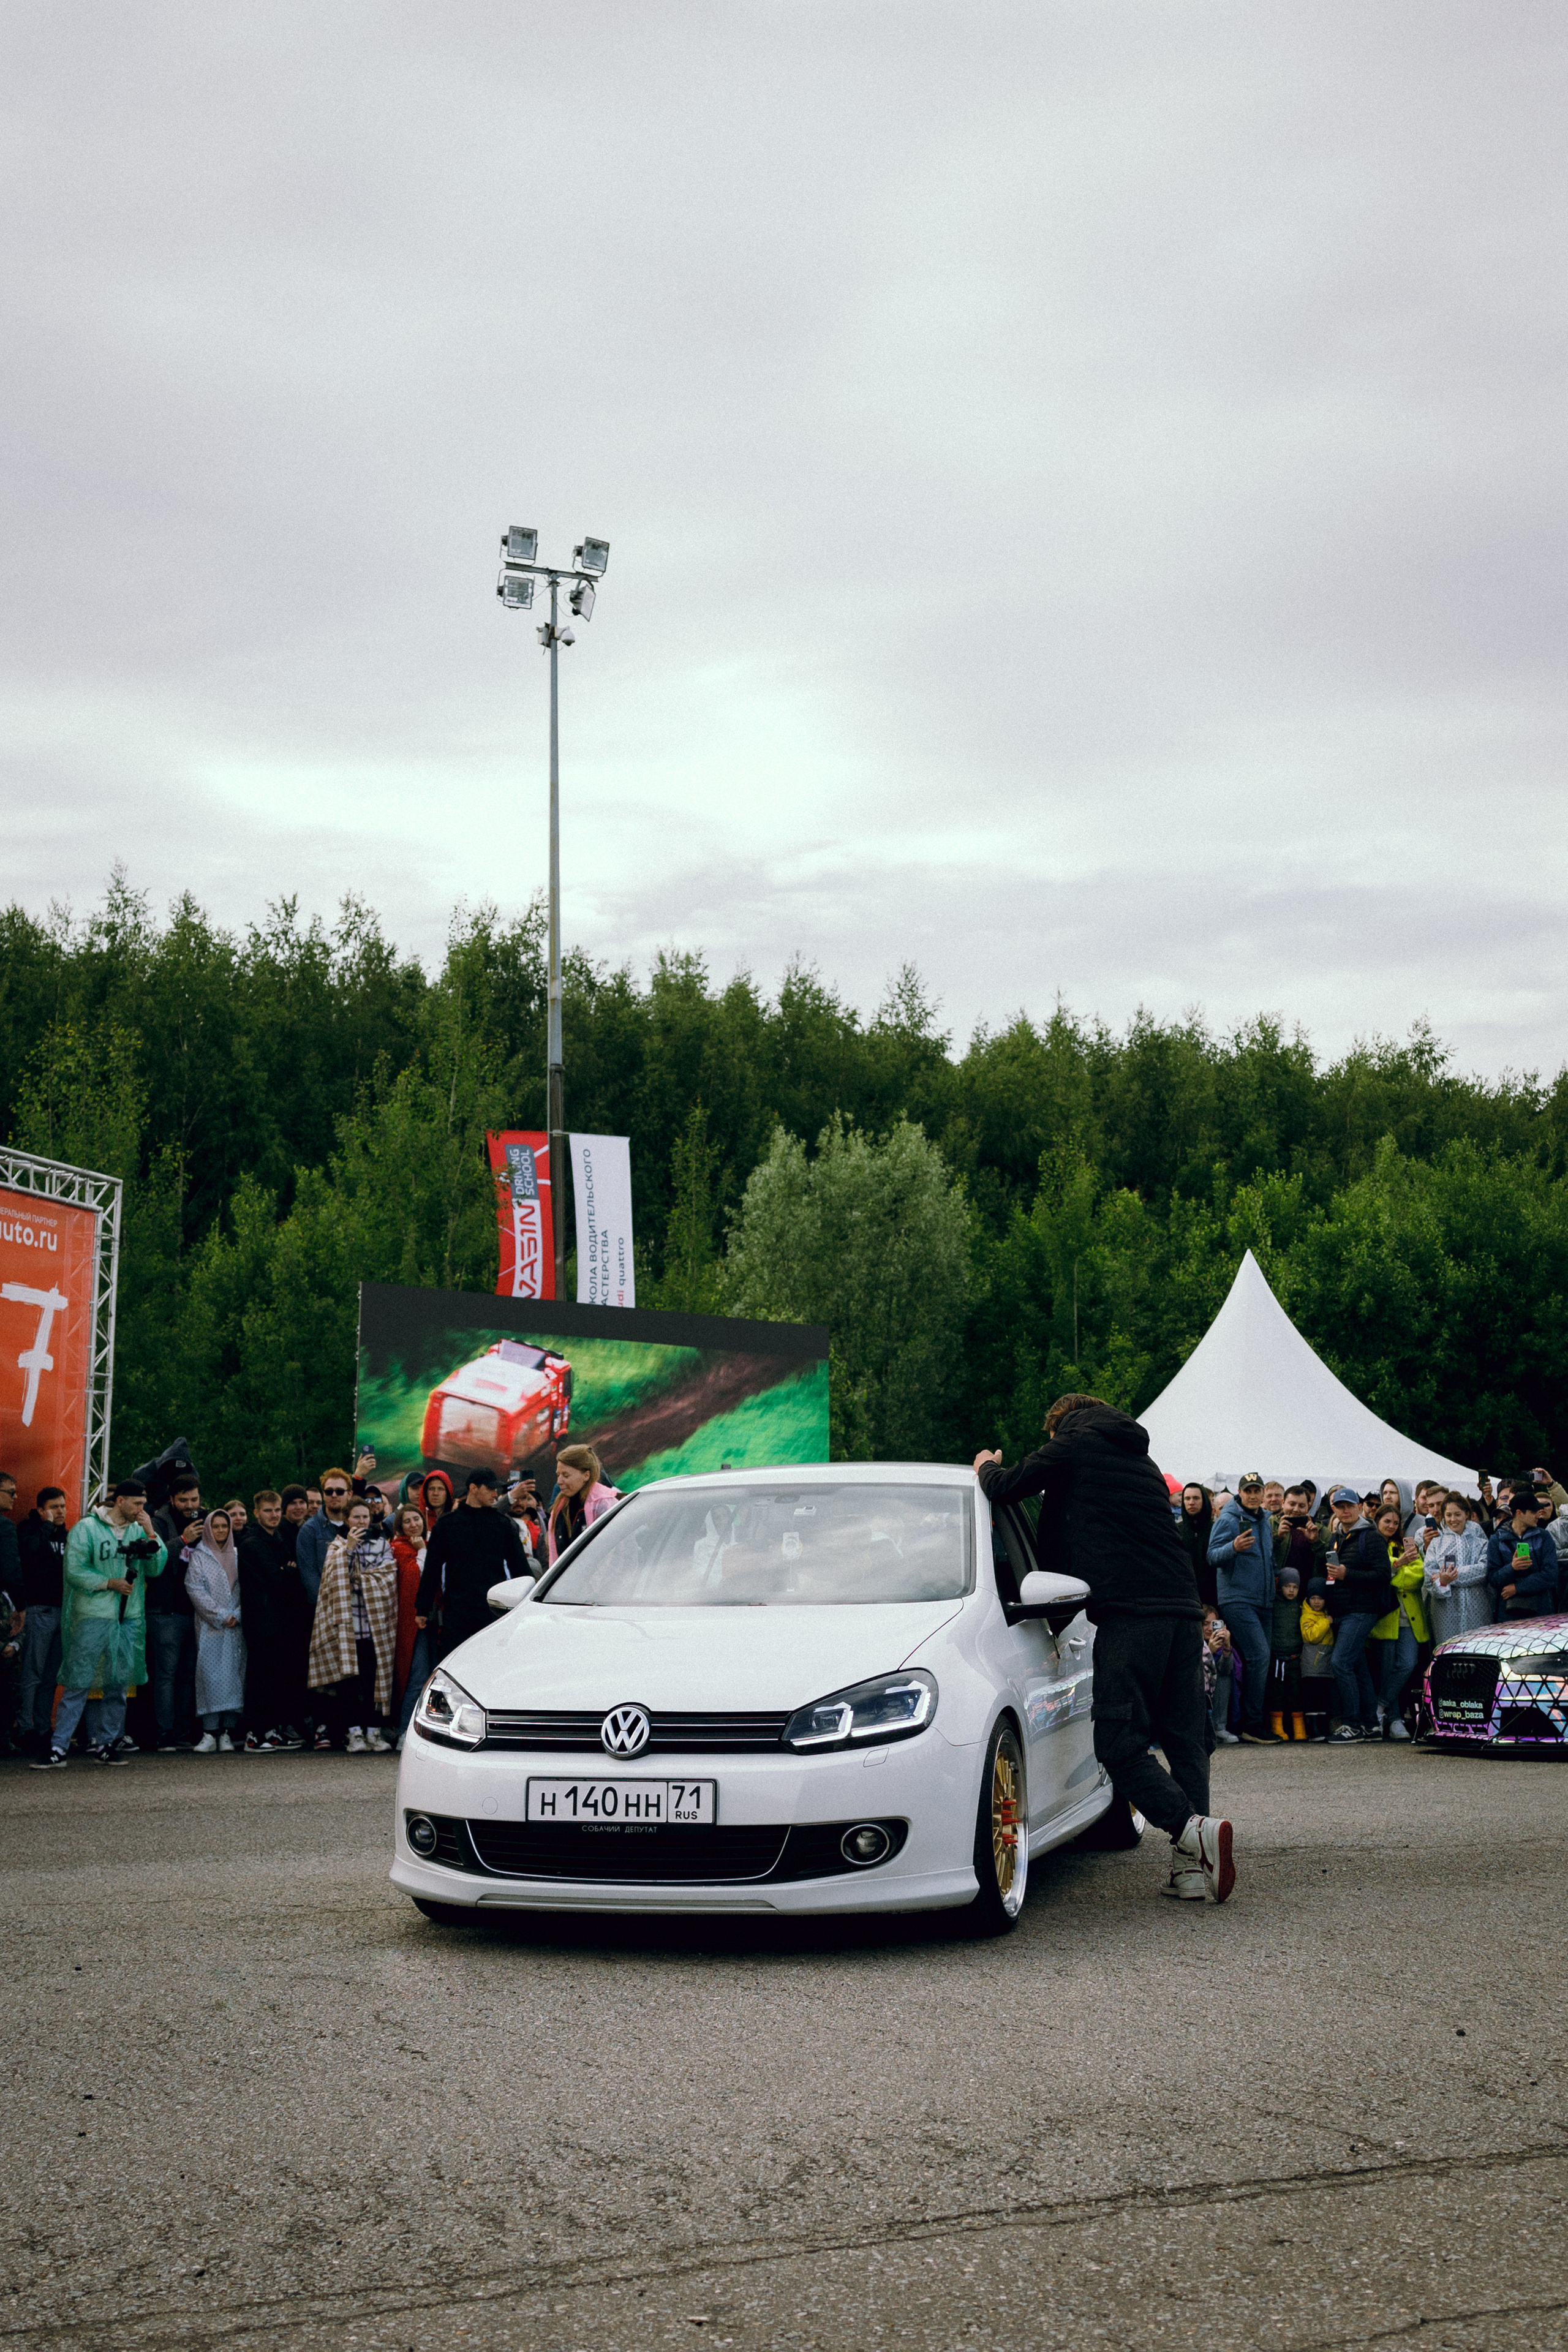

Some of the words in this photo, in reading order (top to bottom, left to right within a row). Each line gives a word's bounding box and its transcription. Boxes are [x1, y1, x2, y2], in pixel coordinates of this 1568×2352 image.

[521, 1149, 535, 1196] SCHOOL
[0, 1207, 31, 1221] ЕРАЛЬНЫЙ
[32, 1214, 58, 1227] ПАРТНЕР
[583, 1149, 598, 1262] ВОДИТЕЛЬСКОГО
[0, 1221, 58, 1251] uto.ru
[600, 1230, 609, 1305] АСТЕРСТВА
[589, 1266, 597, 1303] КОЛА
[1245, 1473, 1257, 1482] W
[1439, 1708, 1484, 1720] @wrap_baza
[672, 1785, 701, 1809] 71
[675, 1811, 698, 1820] RUS
